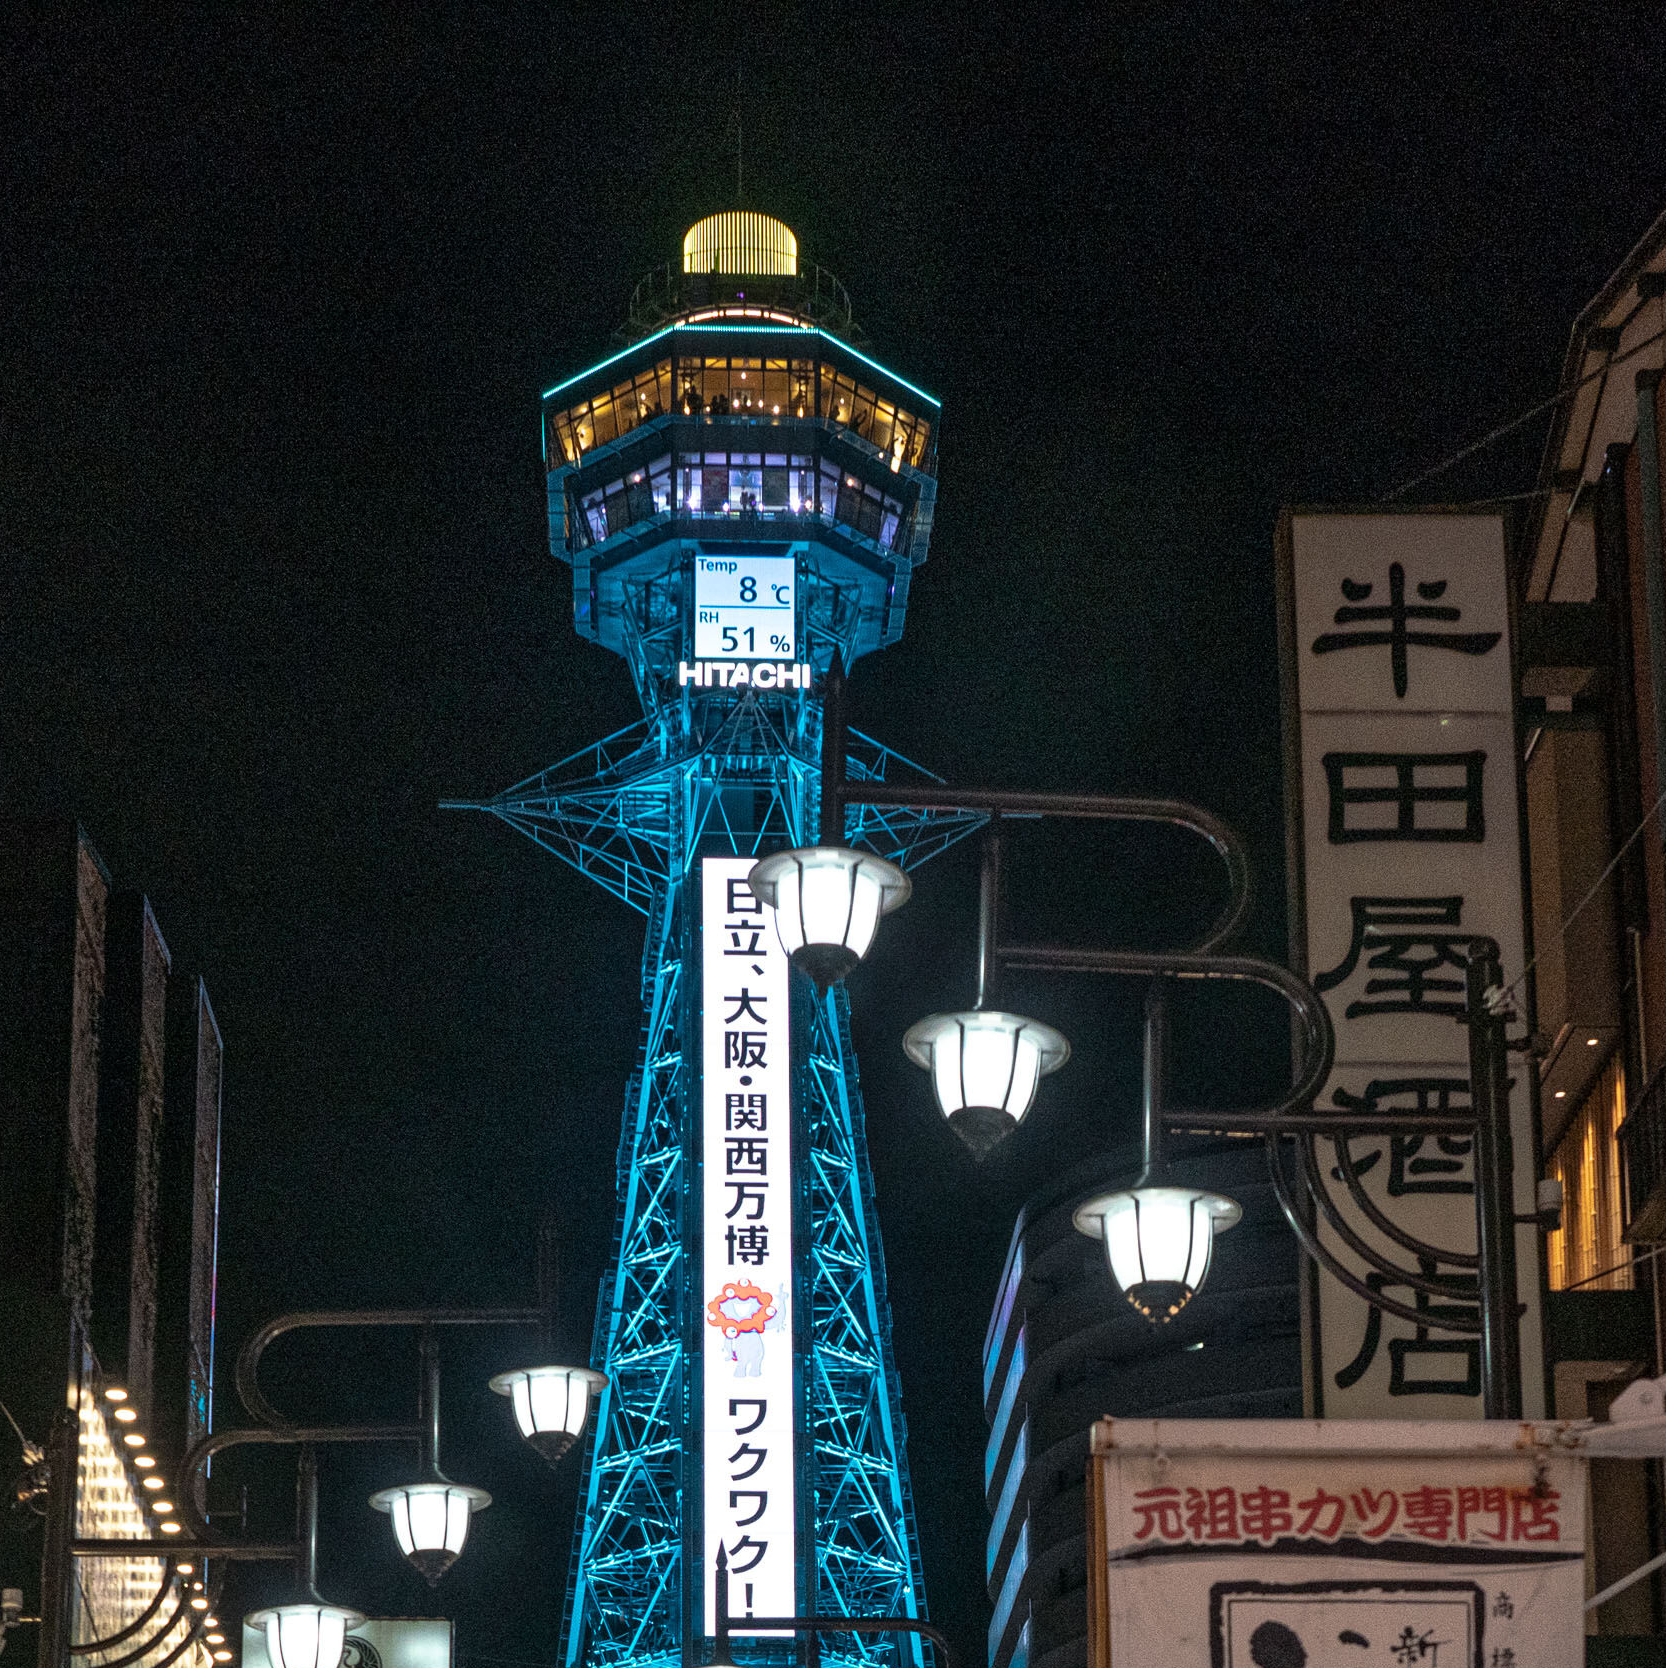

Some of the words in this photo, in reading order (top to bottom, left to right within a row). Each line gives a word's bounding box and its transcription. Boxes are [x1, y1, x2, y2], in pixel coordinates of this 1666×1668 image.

[698, 559, 738, 574] Temp
[699, 612, 719, 624] RH
[721, 626, 756, 652] 51
[770, 635, 790, 653] %
[679, 661, 811, 688] HITACHI
[1132, 1485, 1561, 1543] 元祖串カツ専門店
